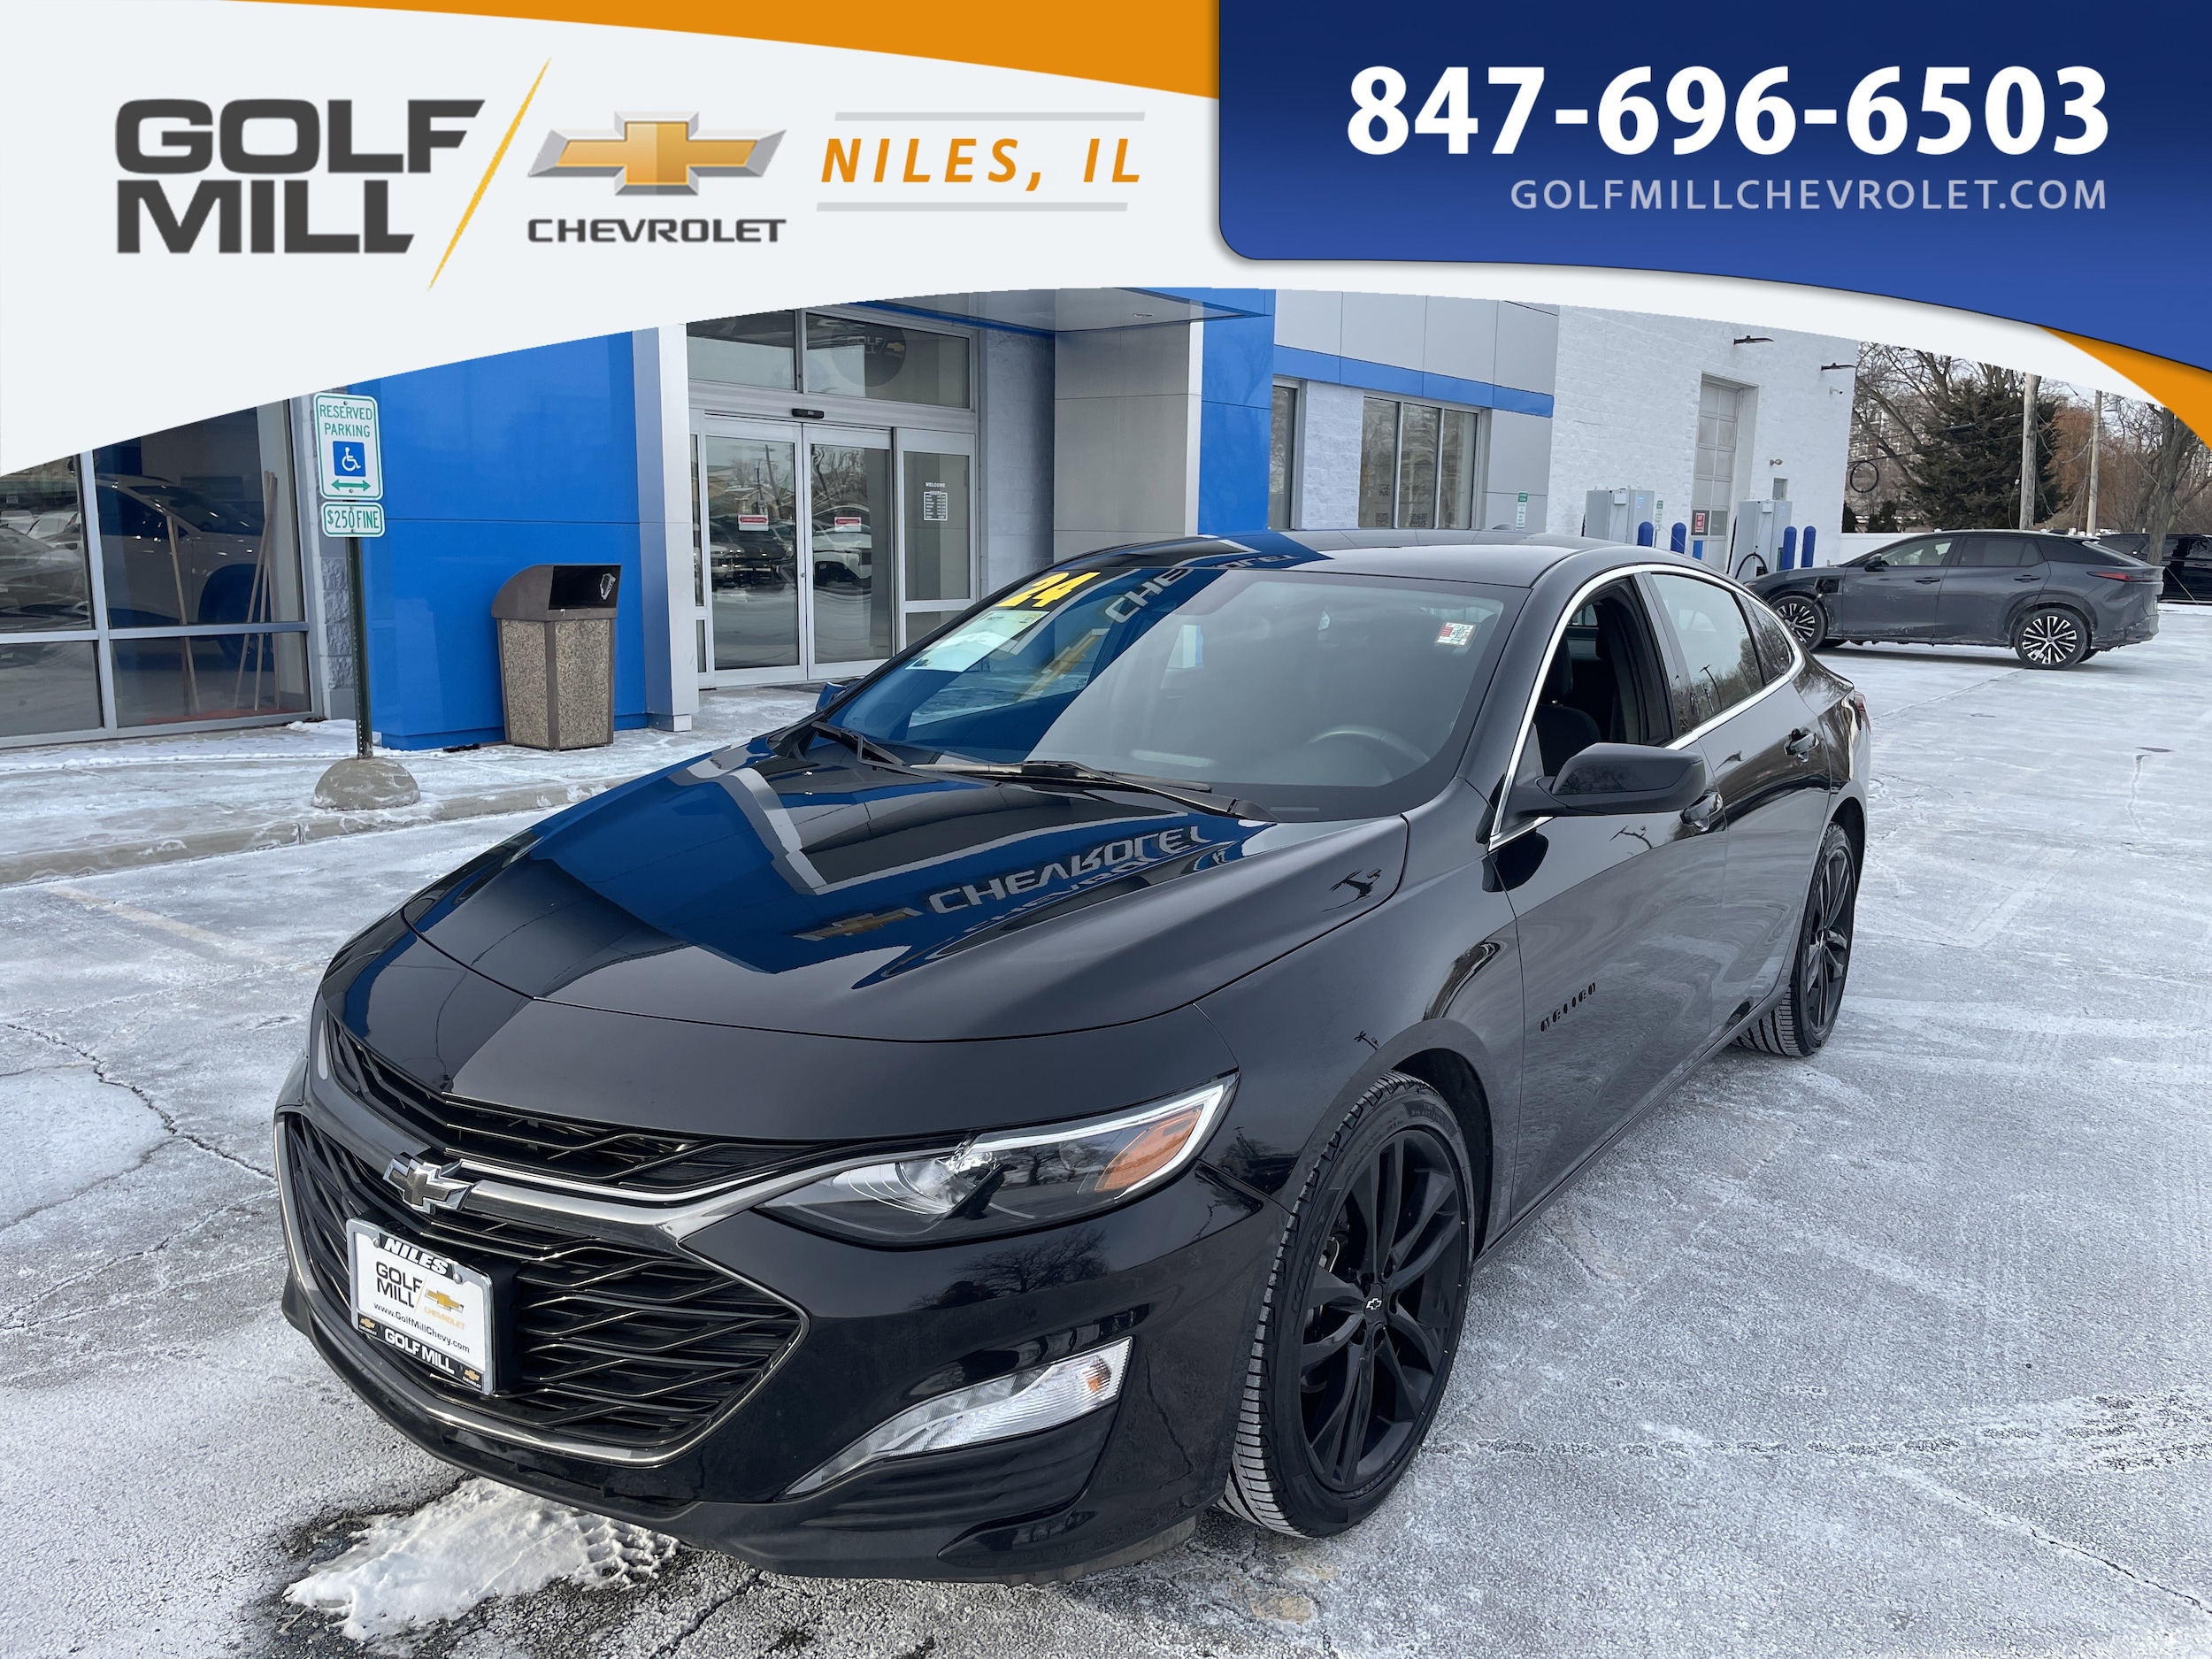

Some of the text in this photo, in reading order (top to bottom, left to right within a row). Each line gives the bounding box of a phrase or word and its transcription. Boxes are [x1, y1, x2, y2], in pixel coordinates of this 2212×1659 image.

[319, 404, 373, 420] RESERVED
[325, 423, 371, 438] PARKING
[326, 510, 380, 529] $250 FINE
[995, 572, 1101, 608] 24
[383, 1238, 449, 1275] NILES
[376, 1261, 423, 1293] GOLF
[377, 1277, 415, 1309] MILL
[373, 1302, 470, 1354] www.GolfMillChevy.com
[424, 1306, 465, 1330] CHEVROLET
[385, 1329, 455, 1375] GOLF MILL
